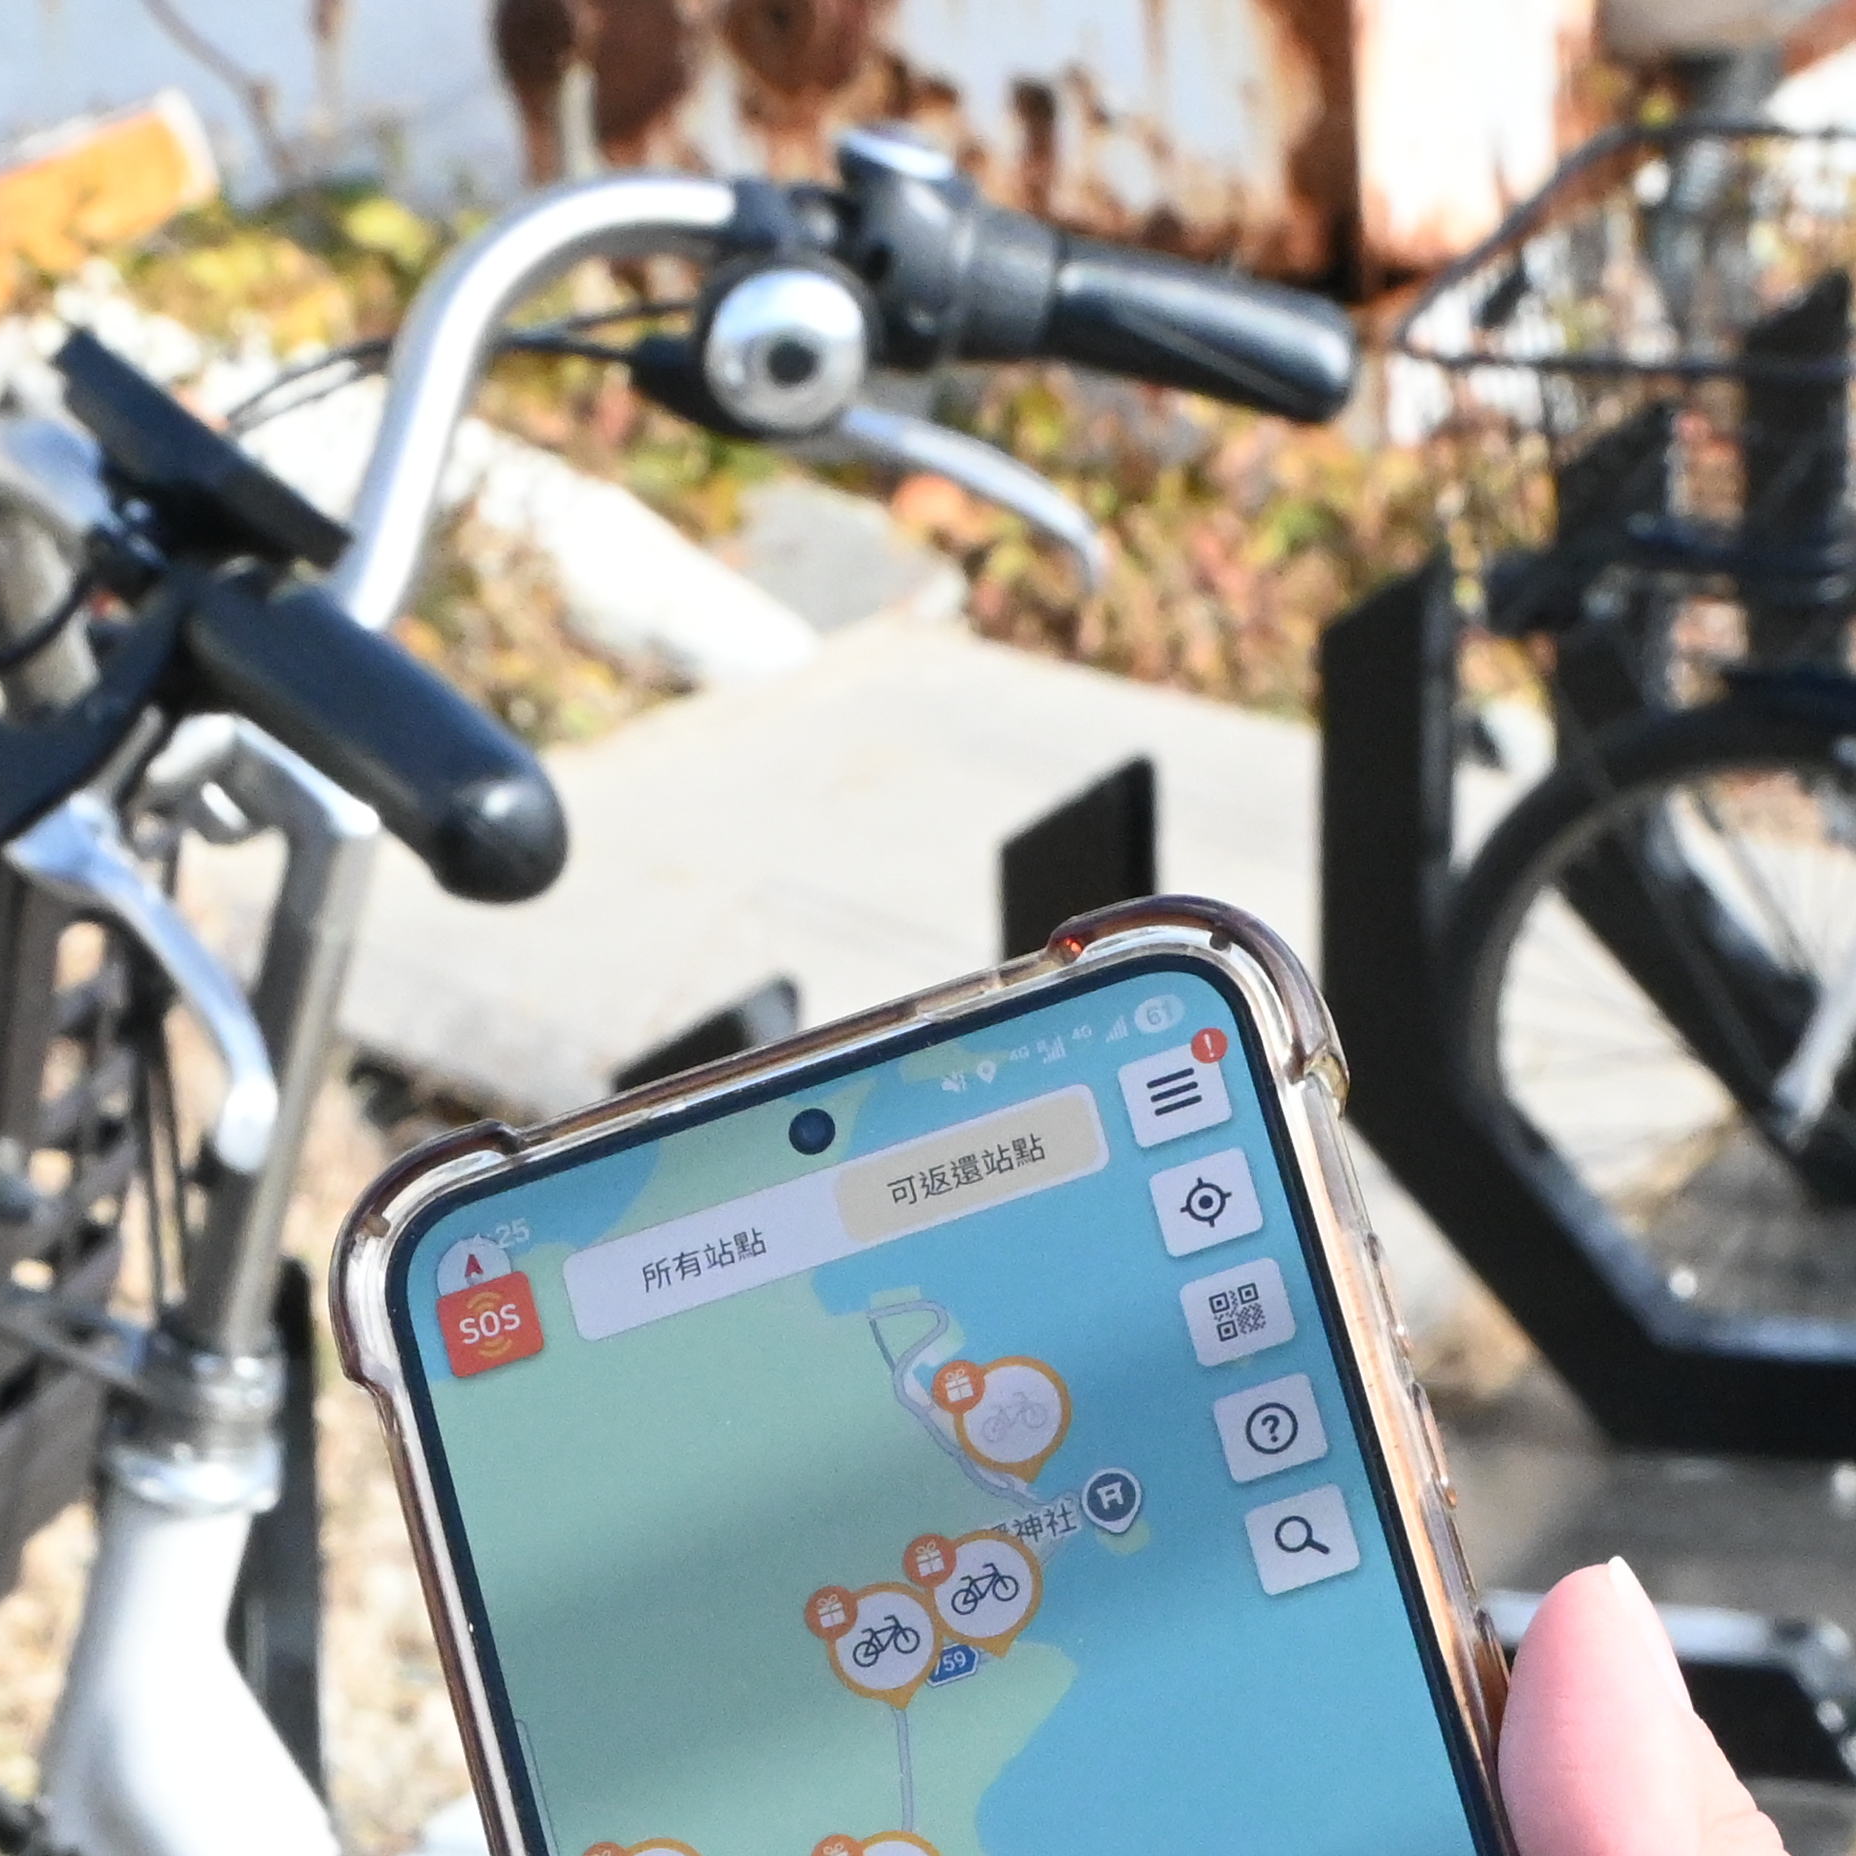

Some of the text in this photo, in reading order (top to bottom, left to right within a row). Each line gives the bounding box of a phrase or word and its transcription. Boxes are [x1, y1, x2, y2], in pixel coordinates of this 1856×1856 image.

[886, 1132, 1047, 1206] 可返還站點
[641, 1227, 768, 1294] 所有站點
[458, 1303, 522, 1345] SOS
